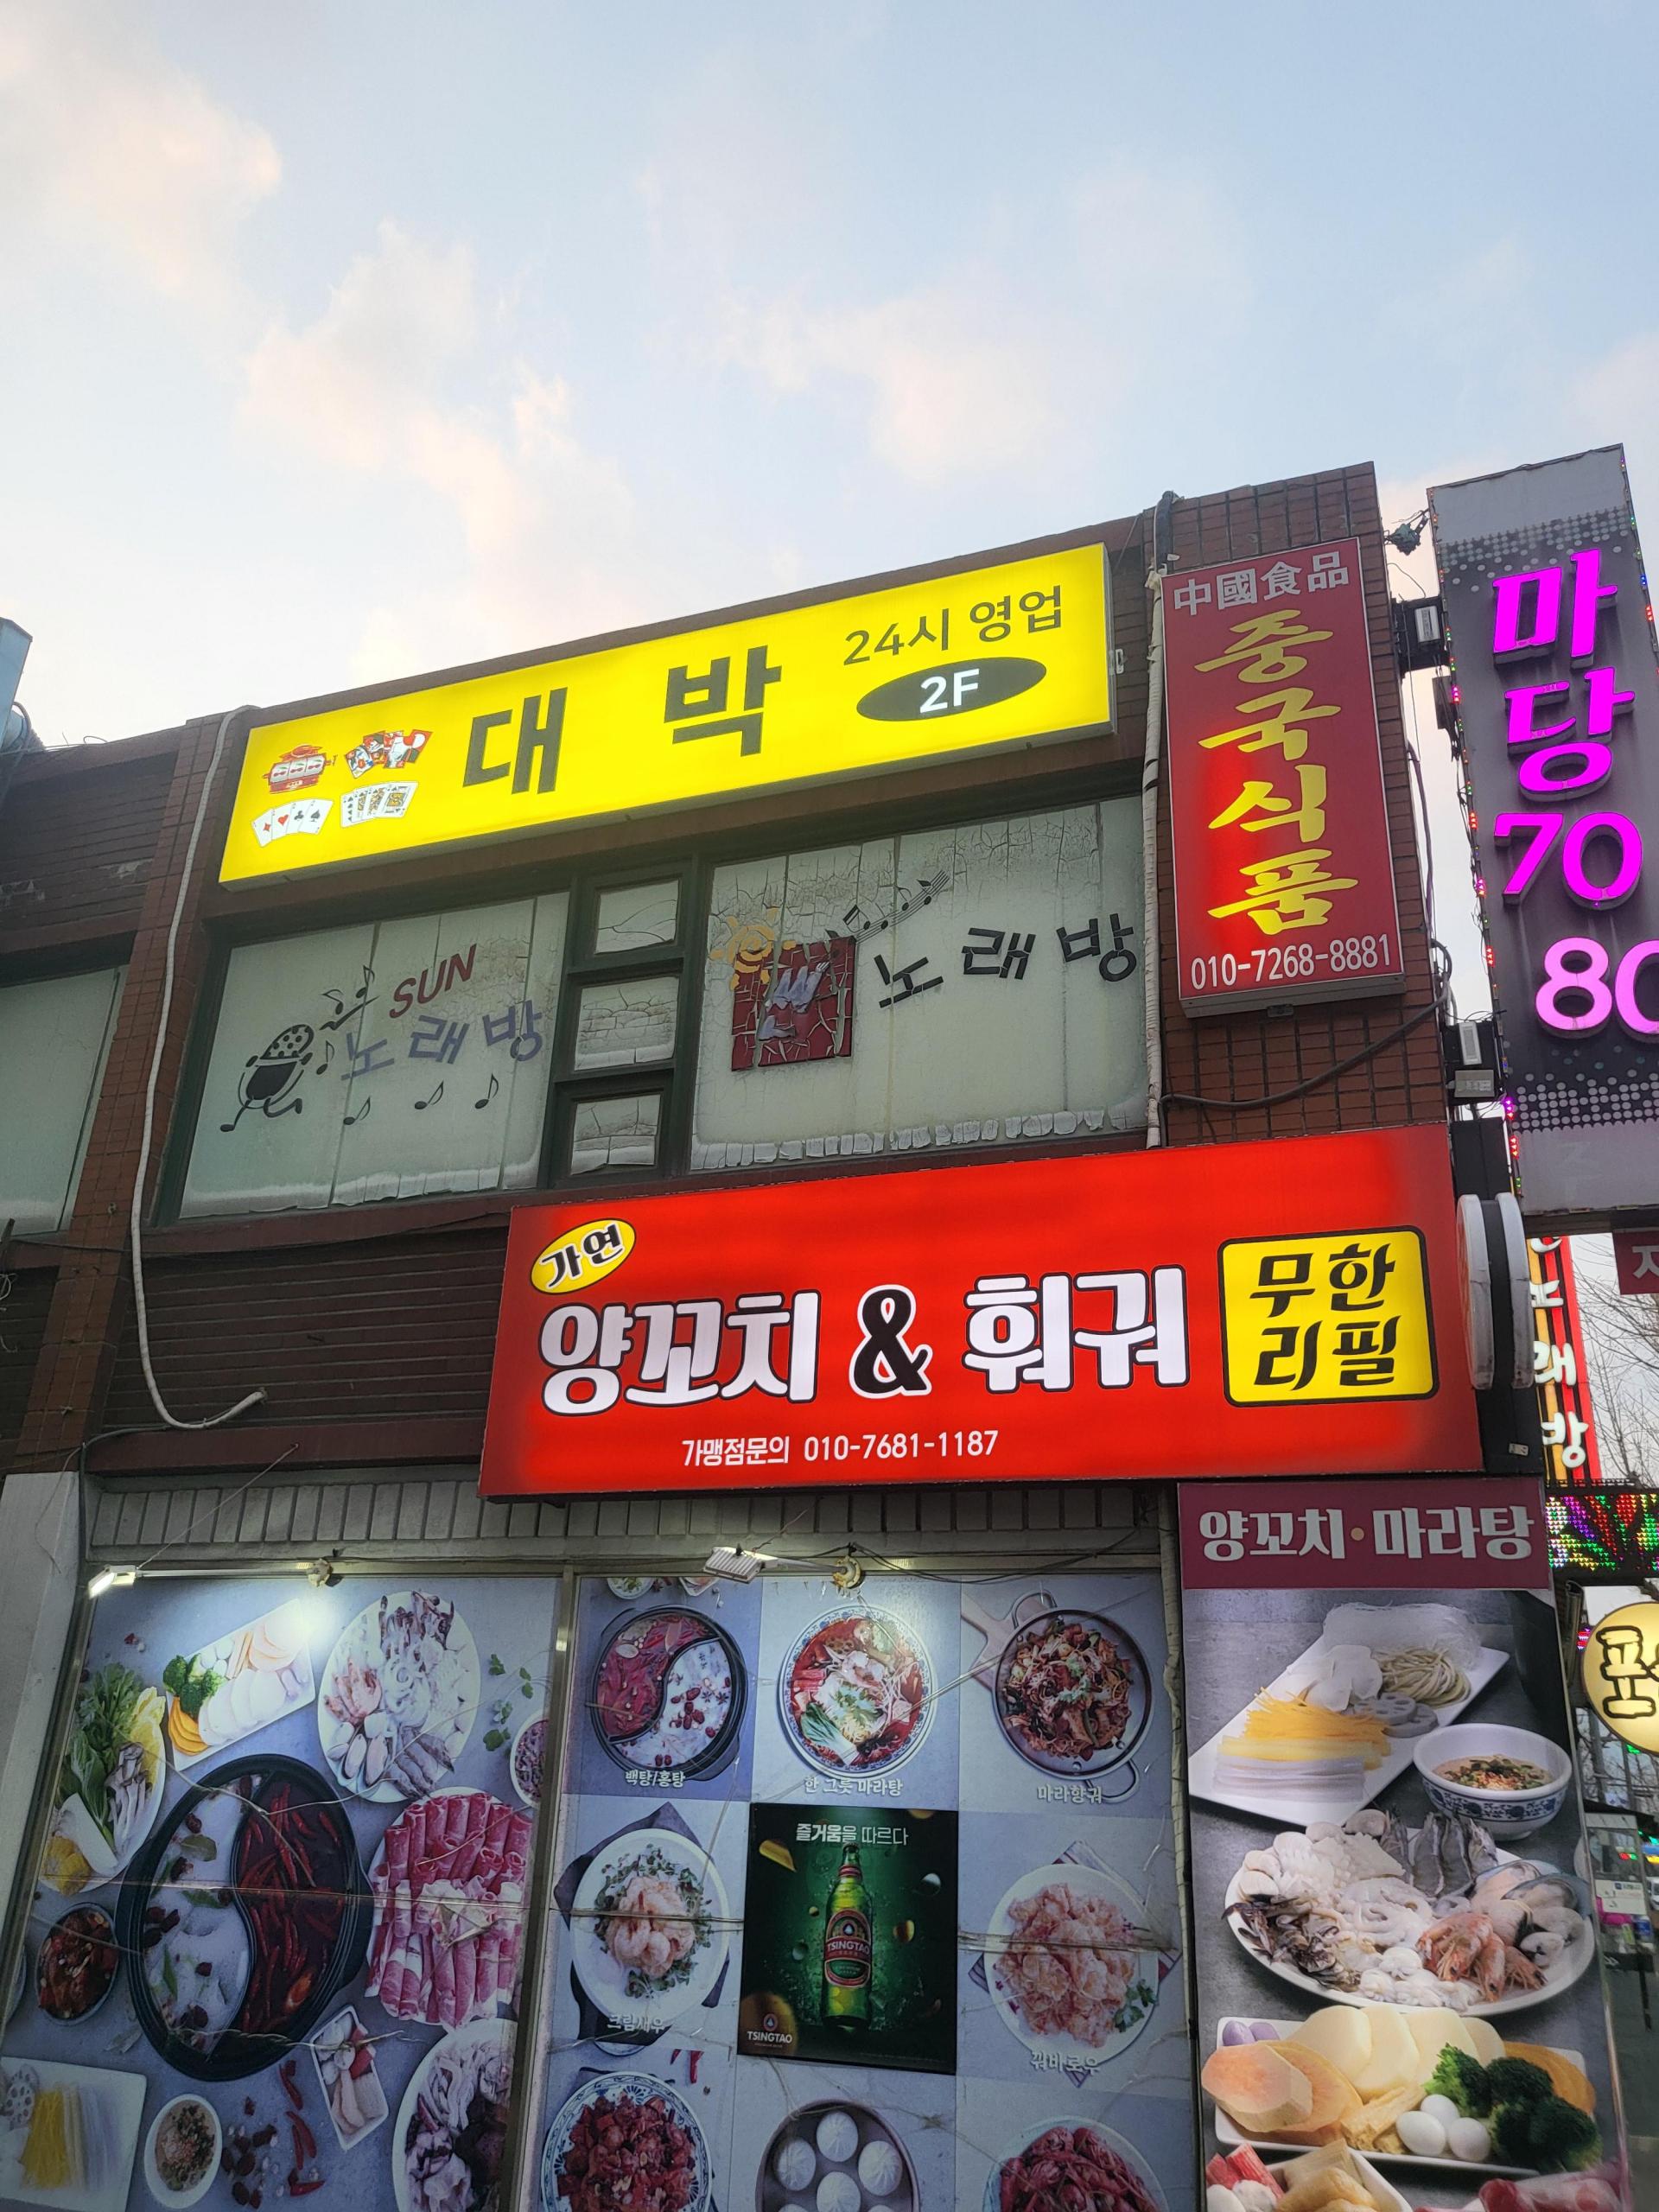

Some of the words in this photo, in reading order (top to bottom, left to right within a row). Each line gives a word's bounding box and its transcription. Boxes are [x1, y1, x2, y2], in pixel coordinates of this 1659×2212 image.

[1173, 551, 1350, 616] 中國食品
[843, 607, 950, 666] 24시
[969, 585, 1062, 643] 영업
[919, 668, 981, 714] 2F
[1492, 549, 1635, 793] 마당
[1194, 609, 1358, 935] 중국식품
[1493, 812, 1643, 909] 70
[388, 944, 478, 1018] SUN
[874, 912, 1137, 1008] 노래방
[1191, 933, 1390, 990] 010-7268-8881
[340, 999, 543, 1081] 노래방
[539, 1222, 624, 1289] 가연
[1249, 1243, 1395, 1318] 무한
[539, 1290, 821, 1416] 양꼬치
[849, 1284, 933, 1398] &
[962, 1264, 1190, 1395] 훠궈
[1254, 1315, 1402, 1391] 리필
[681, 1434, 790, 1467] 가맹점문의
[803, 1429, 999, 1463] 010-7681-1187
[625, 1769, 686, 1789] 백탕/홍탕
[857, 1778, 904, 1796] 마라탕
[1037, 1783, 1103, 1804] 마라향궈
[796, 1823, 857, 1844] 즐거움을
[861, 1826, 909, 1846] 따르다
[827, 1940, 870, 1955] TSINGTAO
[747, 2031, 793, 2044] TSINGTAO
